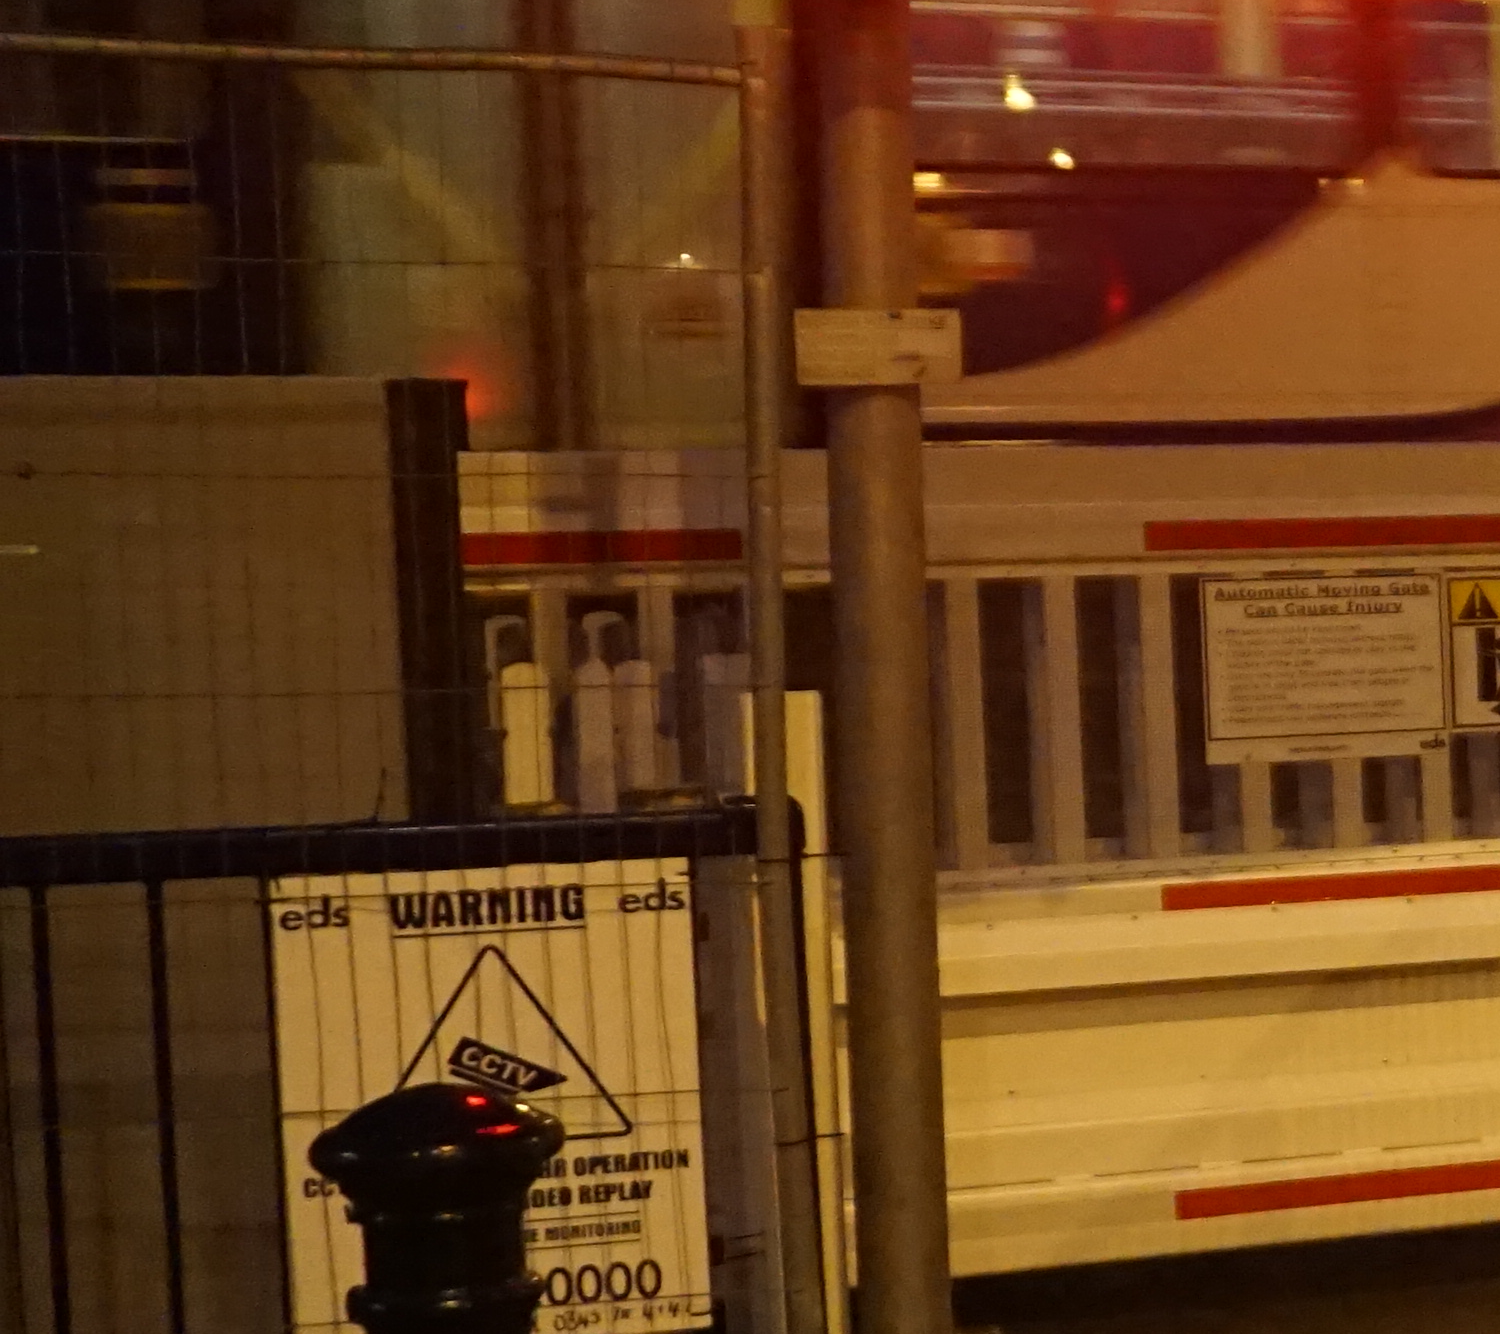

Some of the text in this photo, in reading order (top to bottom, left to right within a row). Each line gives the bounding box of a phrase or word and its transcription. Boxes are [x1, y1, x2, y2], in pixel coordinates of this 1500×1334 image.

[1214, 584, 1309, 599] Automatic
[1389, 580, 1431, 595] Gate
[1244, 604, 1278, 617] Can
[280, 877, 686, 931] eds WARNING eds
[460, 1044, 540, 1086] CCTV
[574, 1149, 689, 1177] OPERATION
[579, 1180, 654, 1205] REPLAY
[545, 1258, 662, 1306] 0000
